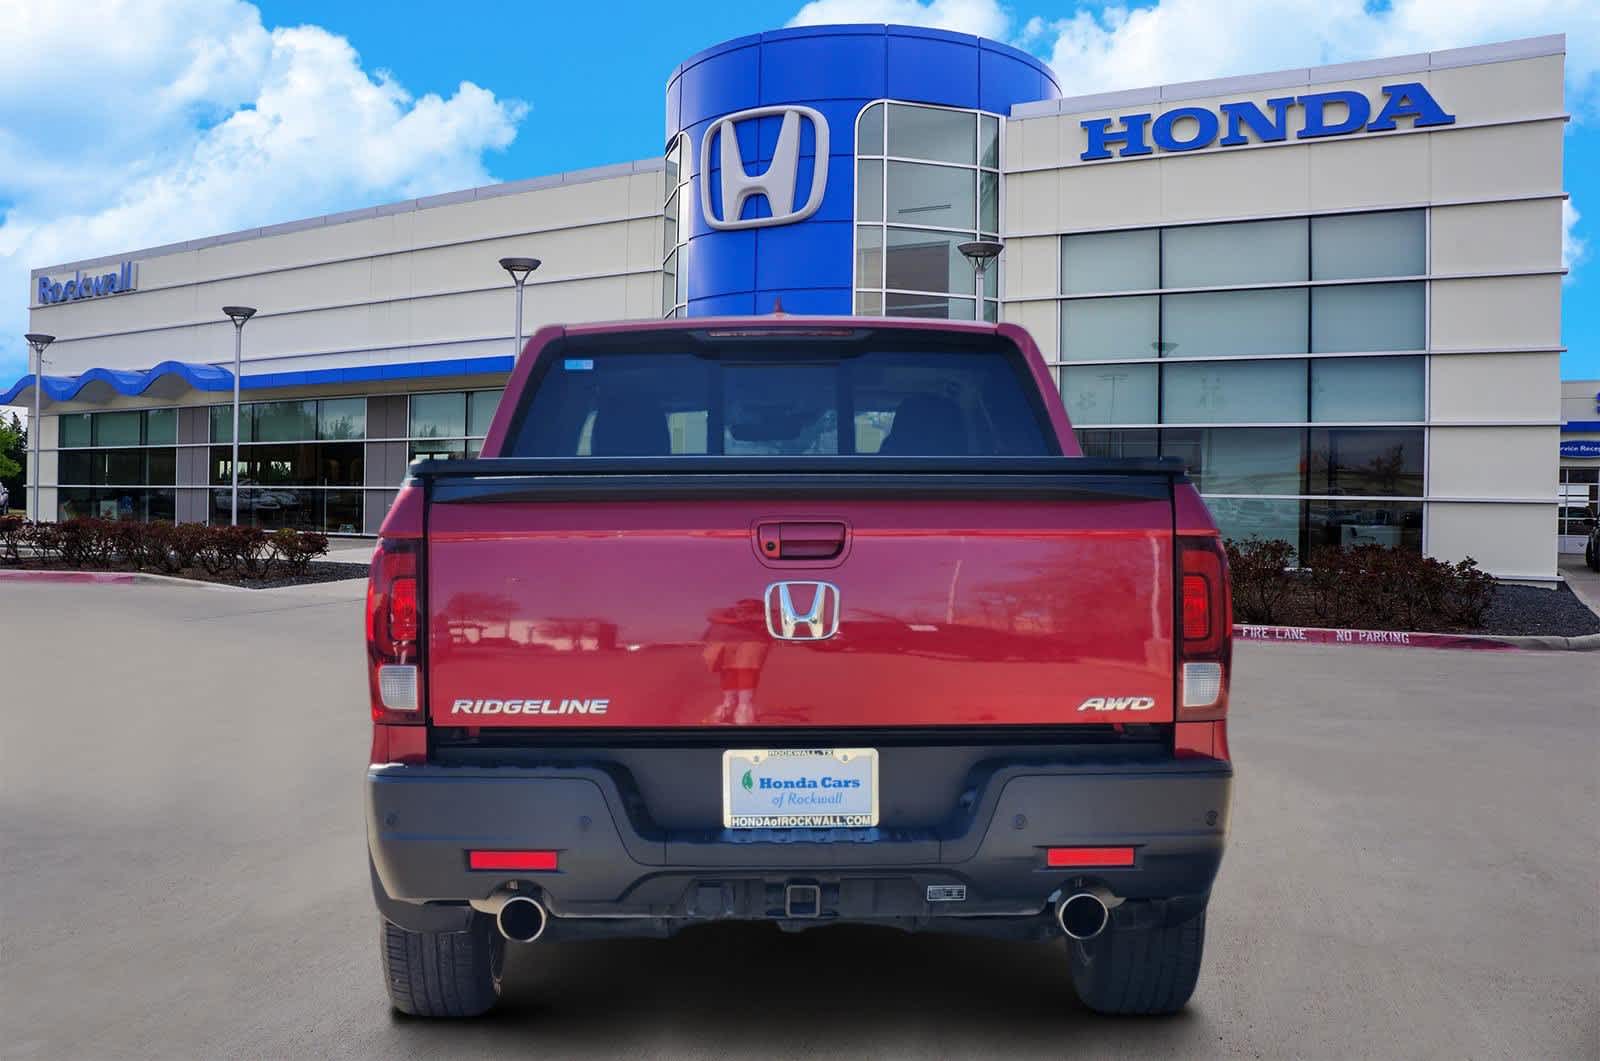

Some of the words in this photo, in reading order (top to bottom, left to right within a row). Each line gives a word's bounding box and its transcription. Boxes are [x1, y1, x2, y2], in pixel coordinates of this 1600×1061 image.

[1080, 82, 1455, 161] HONDA
[38, 261, 133, 304] Rockwall
[1242, 626, 1269, 639] FIRE
[1275, 628, 1307, 641] LANE
[1336, 629, 1352, 641] NO
[1359, 631, 1410, 644] PARKING
[450, 698, 610, 715] RIDGELINE
[1077, 696, 1155, 712] AWD
[759, 777, 817, 789] Honda
[821, 776, 861, 789] Cars
[771, 793, 784, 808] of
[788, 792, 843, 806] Rockwall
